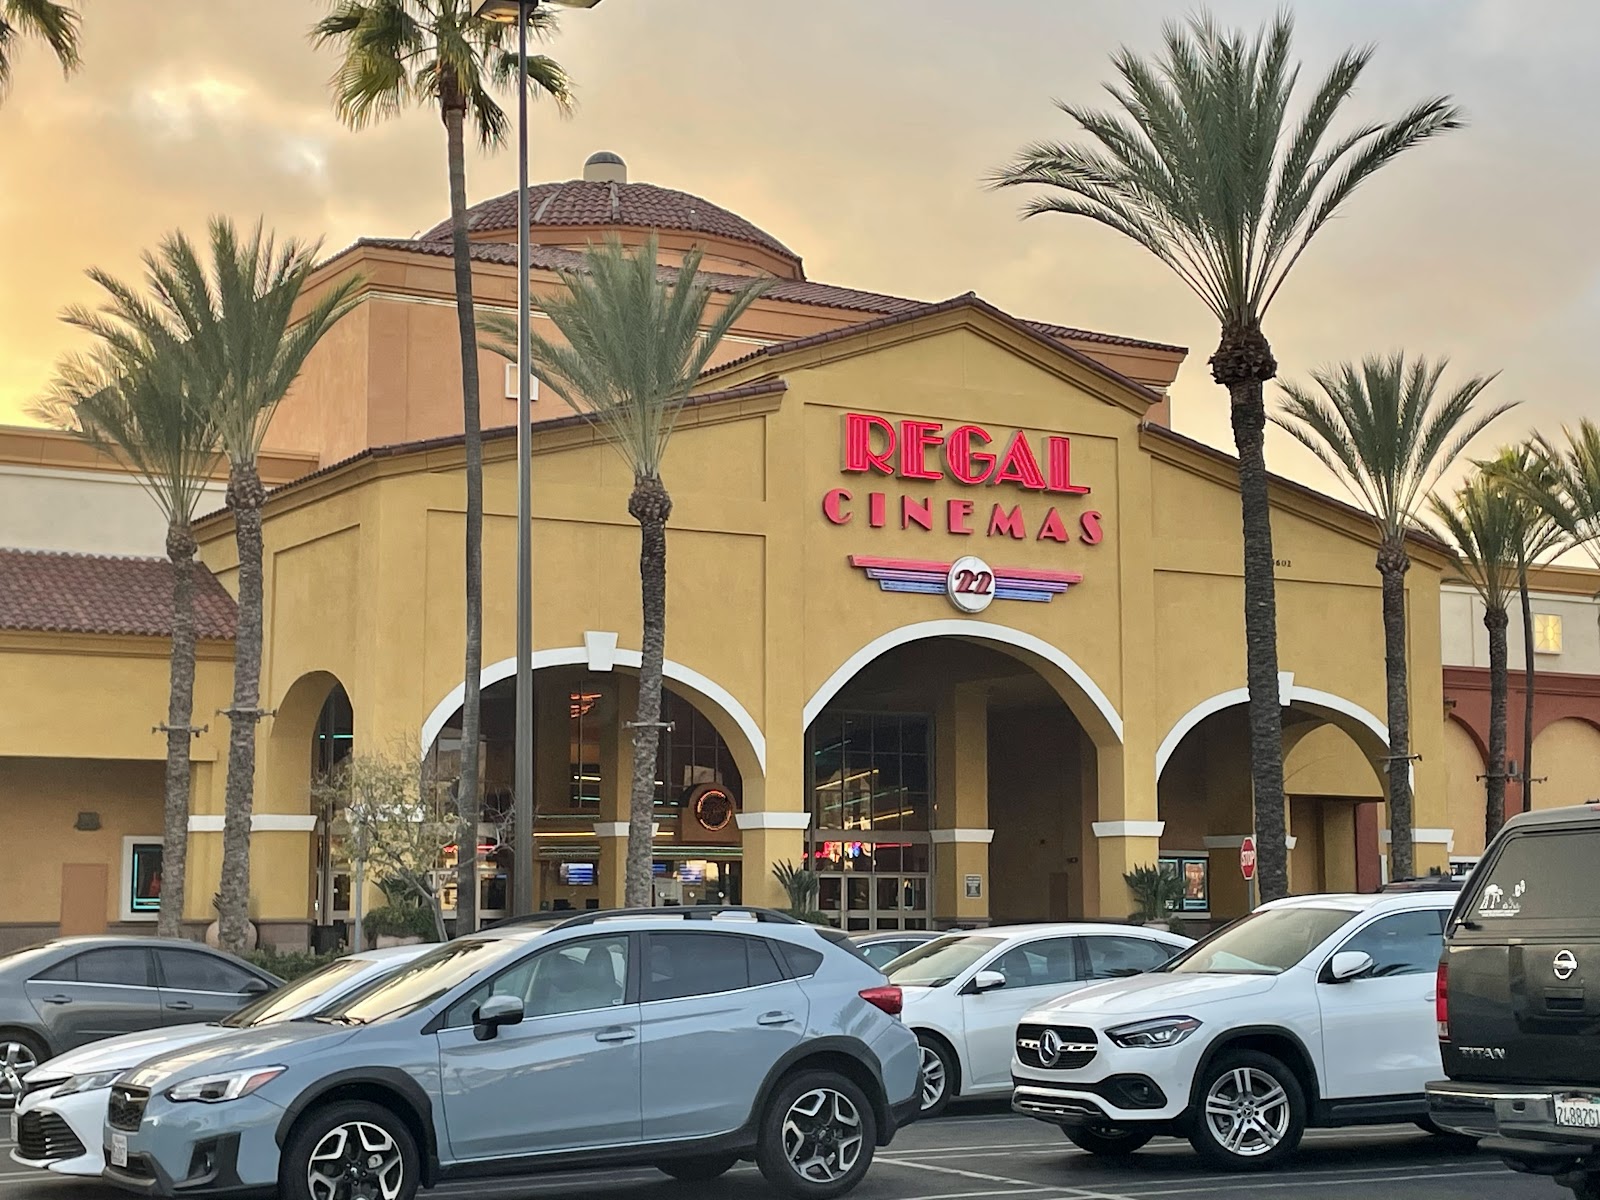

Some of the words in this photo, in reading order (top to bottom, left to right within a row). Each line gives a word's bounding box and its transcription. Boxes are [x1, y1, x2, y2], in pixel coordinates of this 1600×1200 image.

[840, 412, 1091, 495] REGAL
[823, 488, 1104, 545] CINEMAS
[955, 569, 992, 595] 22
[1241, 851, 1255, 867] STOP
[1459, 1046, 1505, 1060] TITAN
